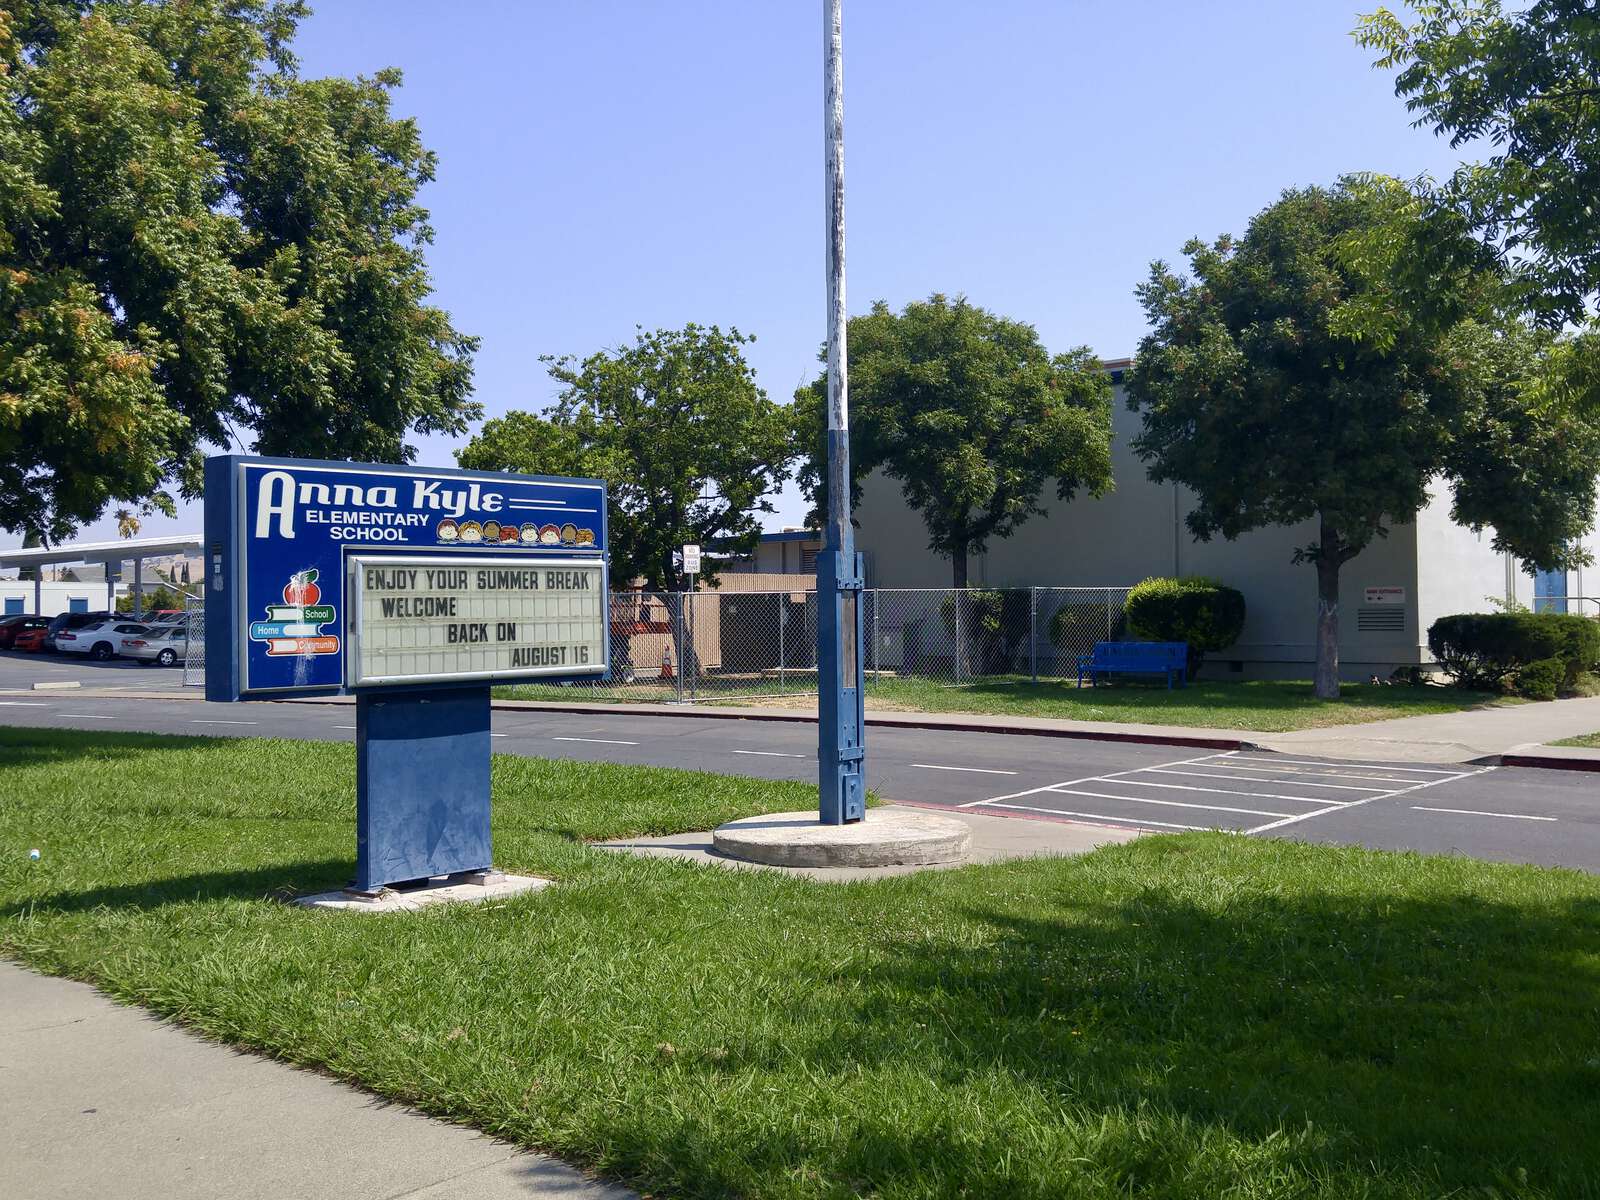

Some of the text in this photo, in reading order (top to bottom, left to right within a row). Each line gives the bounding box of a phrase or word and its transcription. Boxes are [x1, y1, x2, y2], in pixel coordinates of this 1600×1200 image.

[255, 471, 504, 539] Anna Kyle
[306, 510, 429, 527] ELEMENTARY
[330, 526, 409, 541] SCHOOL
[366, 569, 590, 590] ENJOY YOUR SUMMER BREAK
[305, 609, 329, 619] School
[382, 597, 457, 618] WELCOME
[257, 626, 280, 635] Home
[448, 622, 516, 644] BACK ON
[299, 641, 336, 650] Cmunity
[512, 646, 589, 667] AUGUST 16
